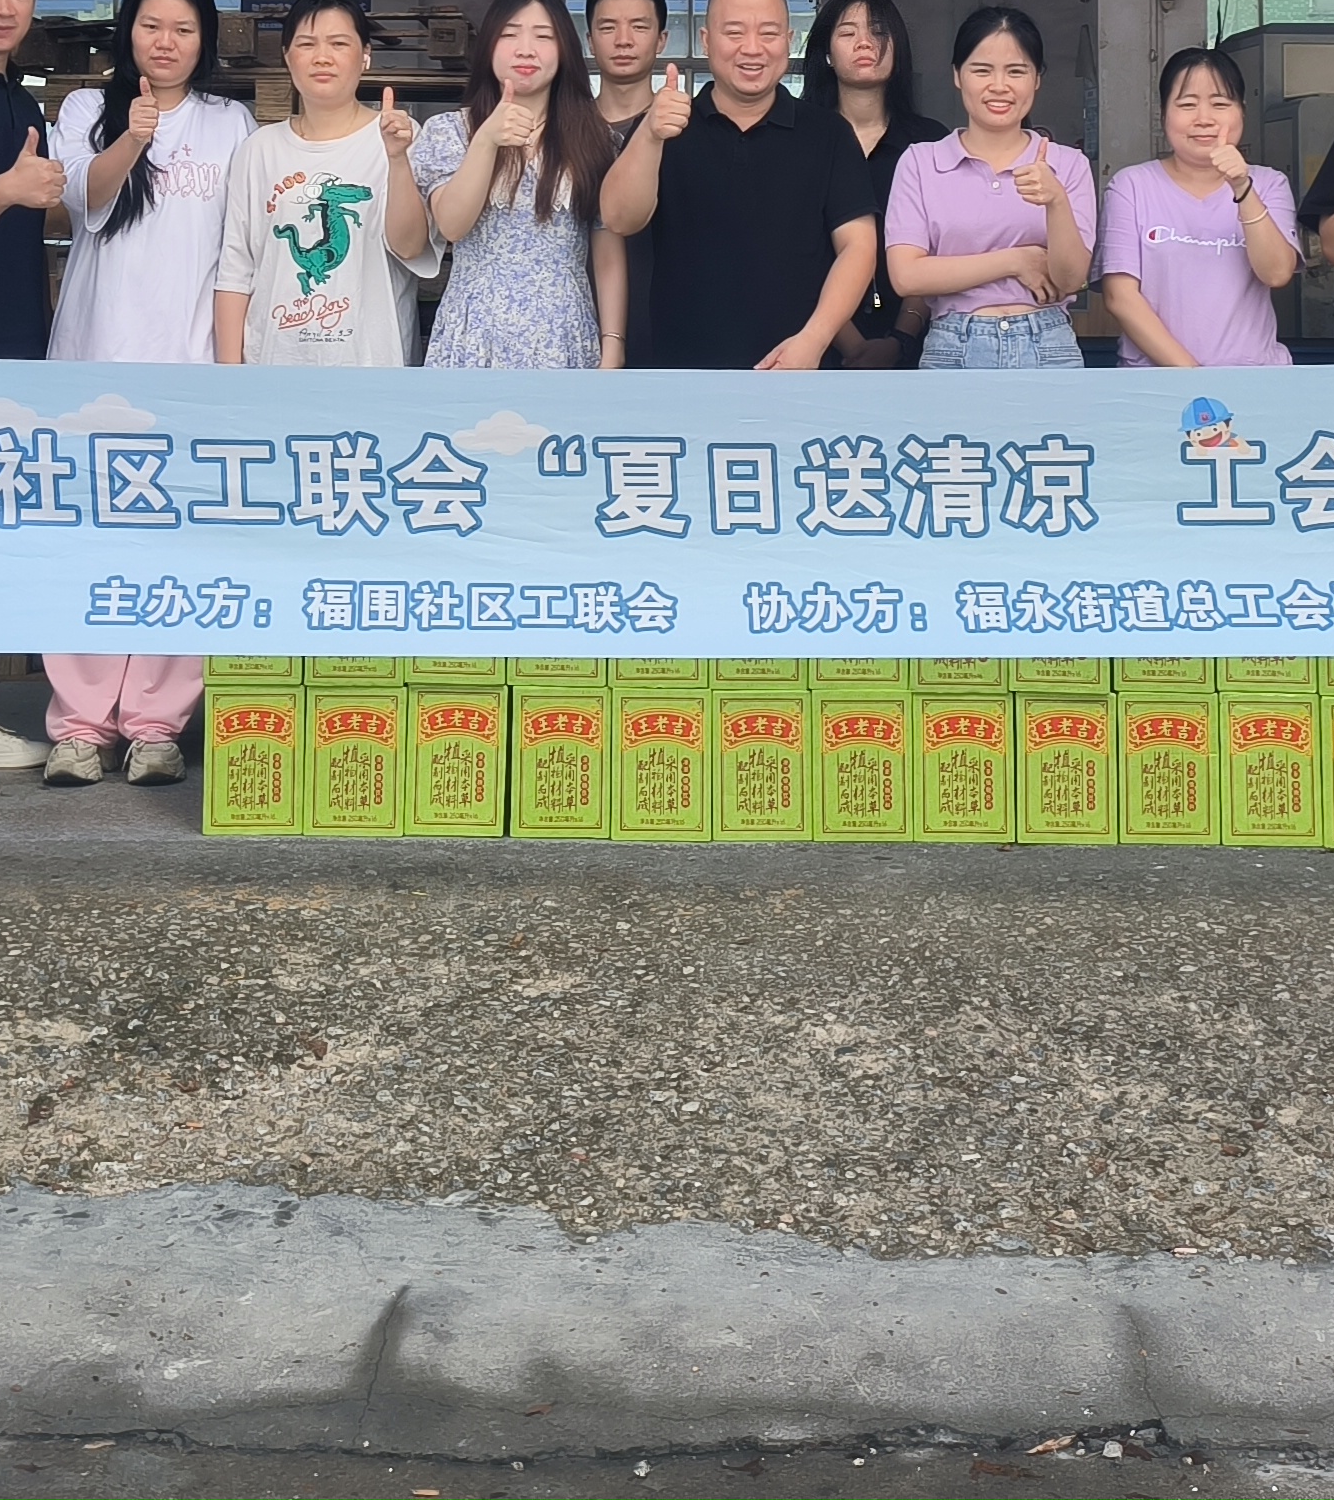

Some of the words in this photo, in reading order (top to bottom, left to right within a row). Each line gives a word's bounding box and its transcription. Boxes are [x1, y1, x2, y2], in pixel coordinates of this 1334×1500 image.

[1147, 226, 1247, 255] Champi
[302, 578, 678, 633] 福围社区工联会
[230, 712, 280, 732] 王老吉
[332, 712, 382, 733] 王老吉
[433, 708, 483, 729] 王老吉
[538, 712, 588, 732] 王老吉
[638, 714, 688, 735] 王老吉
[738, 716, 788, 736] 王老吉
[838, 718, 888, 738] 王老吉
[939, 717, 989, 738] 王老吉
[1041, 718, 1091, 738] 王老吉
[1143, 717, 1193, 738] 王老吉
[1247, 718, 1297, 739] 王老吉
